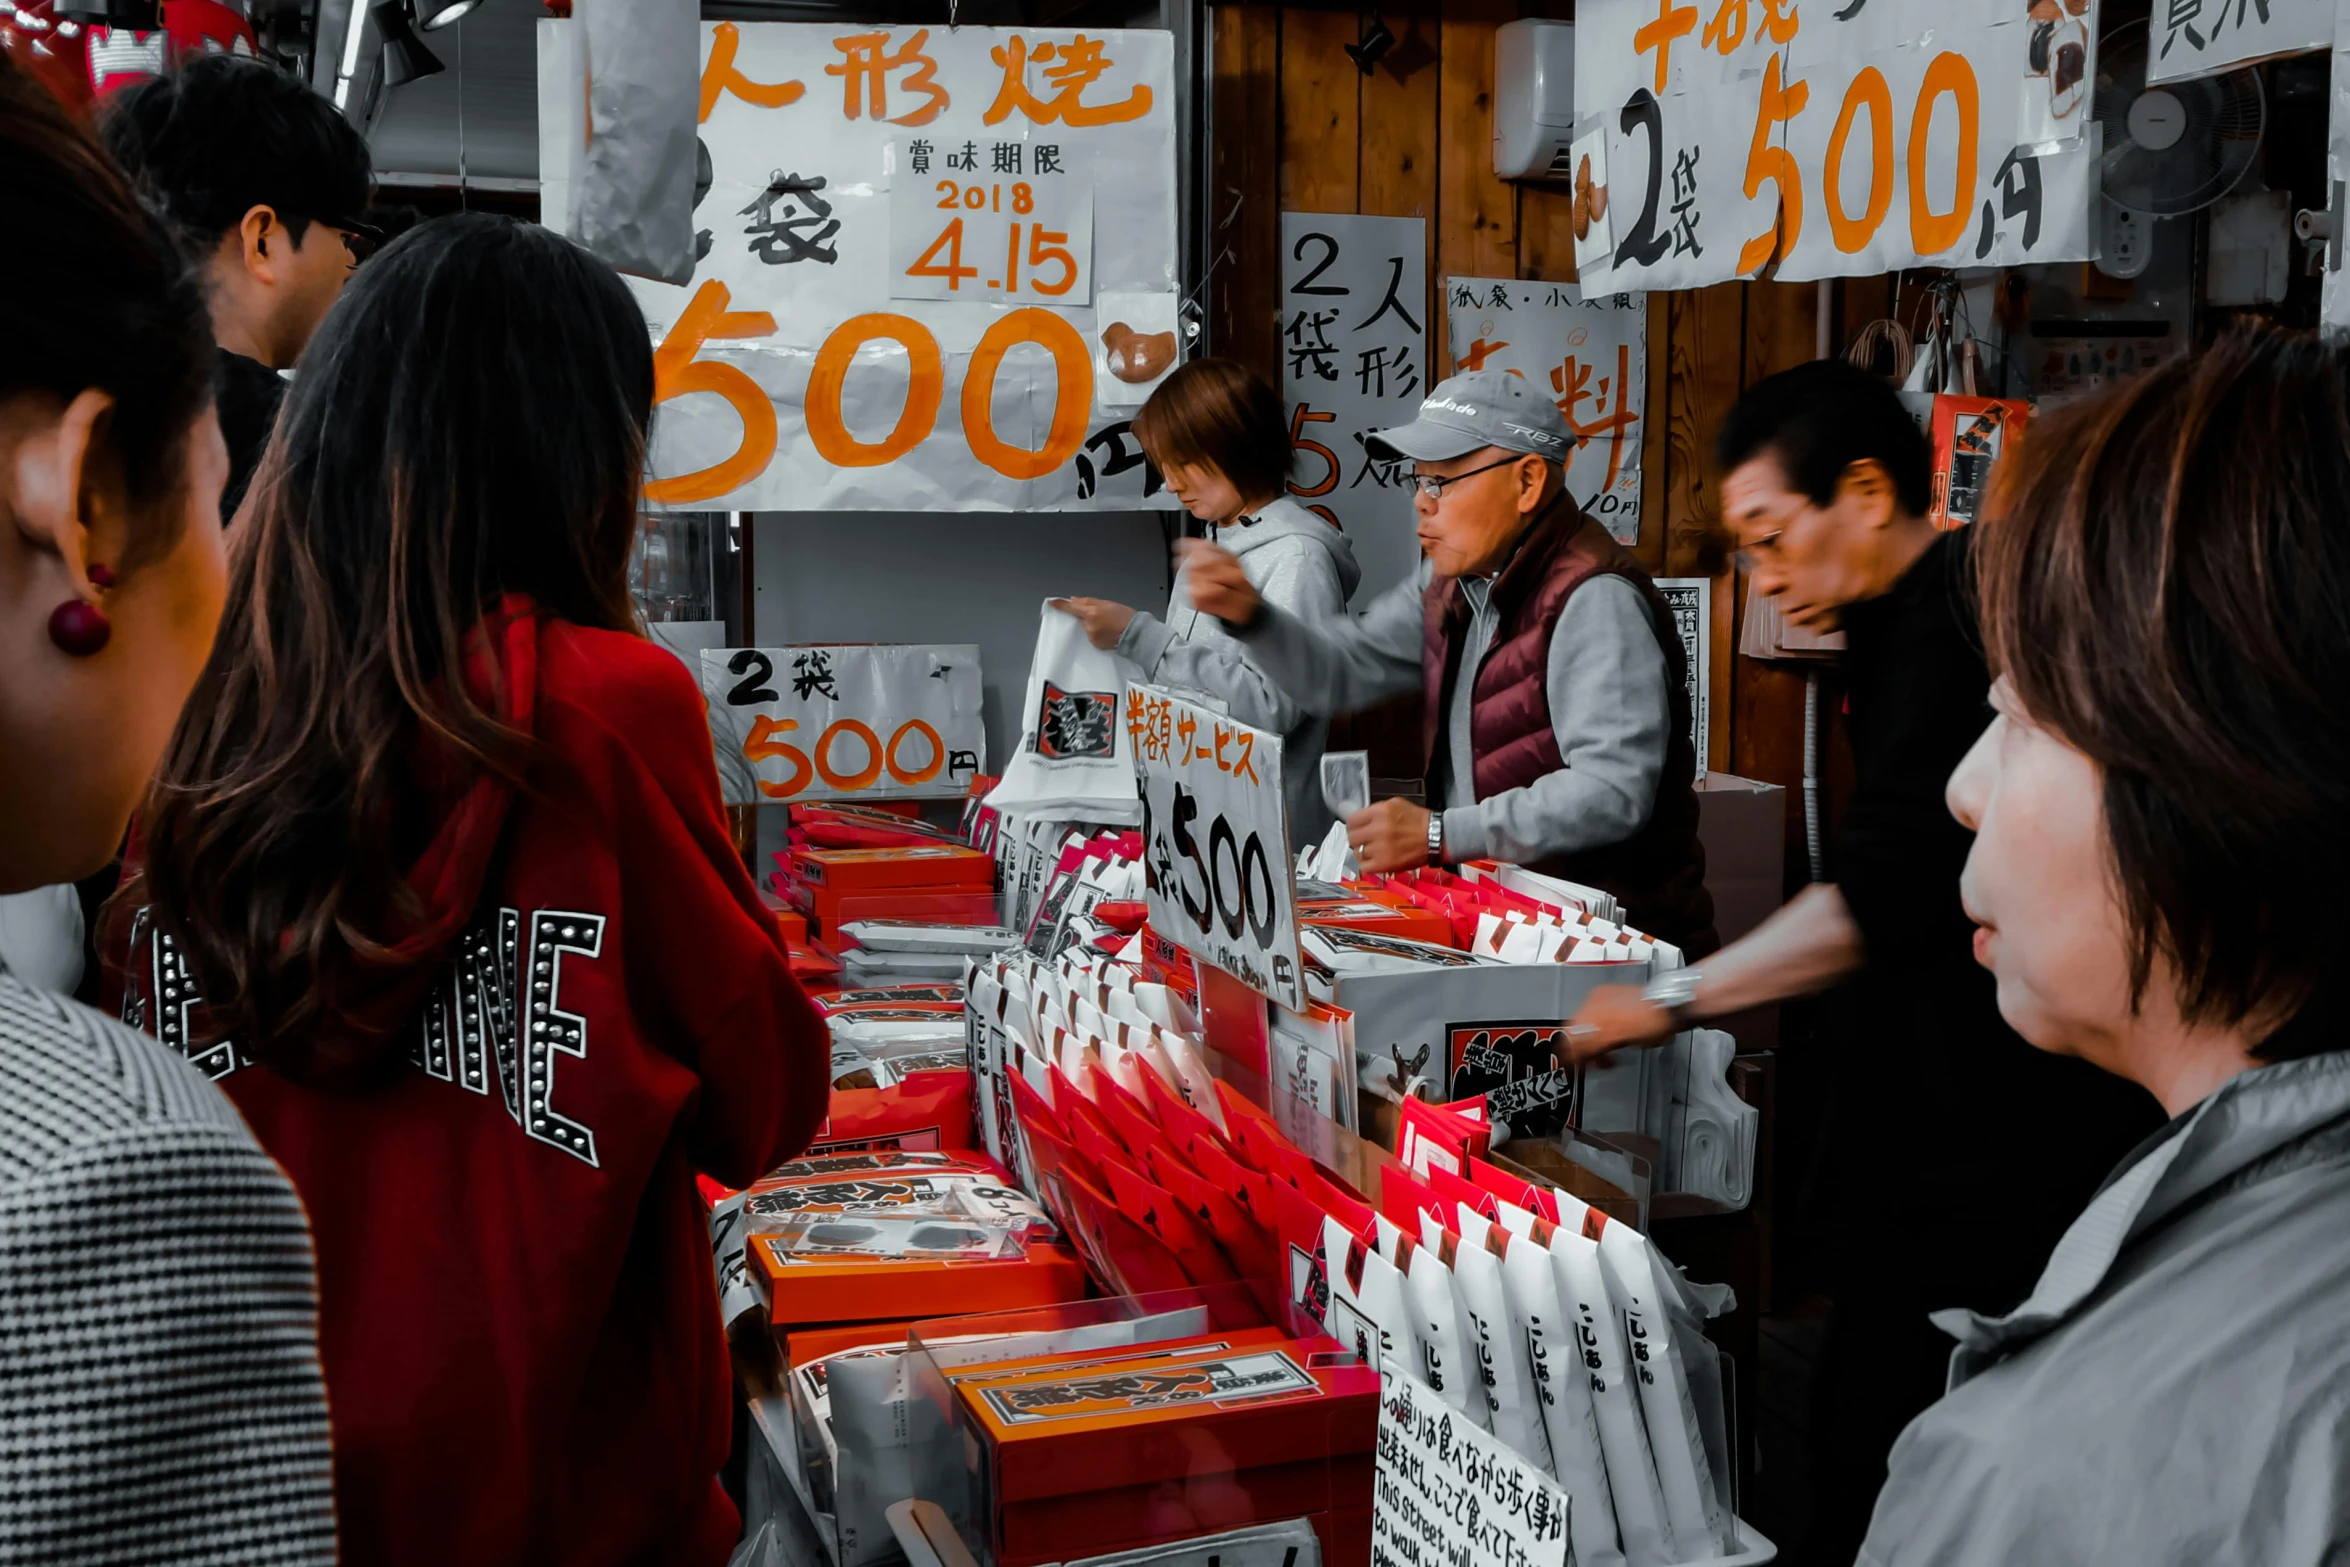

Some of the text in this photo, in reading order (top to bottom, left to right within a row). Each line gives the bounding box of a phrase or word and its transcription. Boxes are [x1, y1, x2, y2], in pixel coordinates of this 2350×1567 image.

[909, 139, 1065, 175] 賞味期限
[936, 179, 1034, 215] 2018
[904, 216, 1078, 296] 4.15
[1126, 688, 1259, 788] 半額サービス
[1530, 1315, 1556, 1406] こしあん
[1579, 1302, 1607, 1394] こしあん
[1375, 1466, 1399, 1513] This
[1401, 1495, 1446, 1553] street
[1375, 1506, 1388, 1536] to
